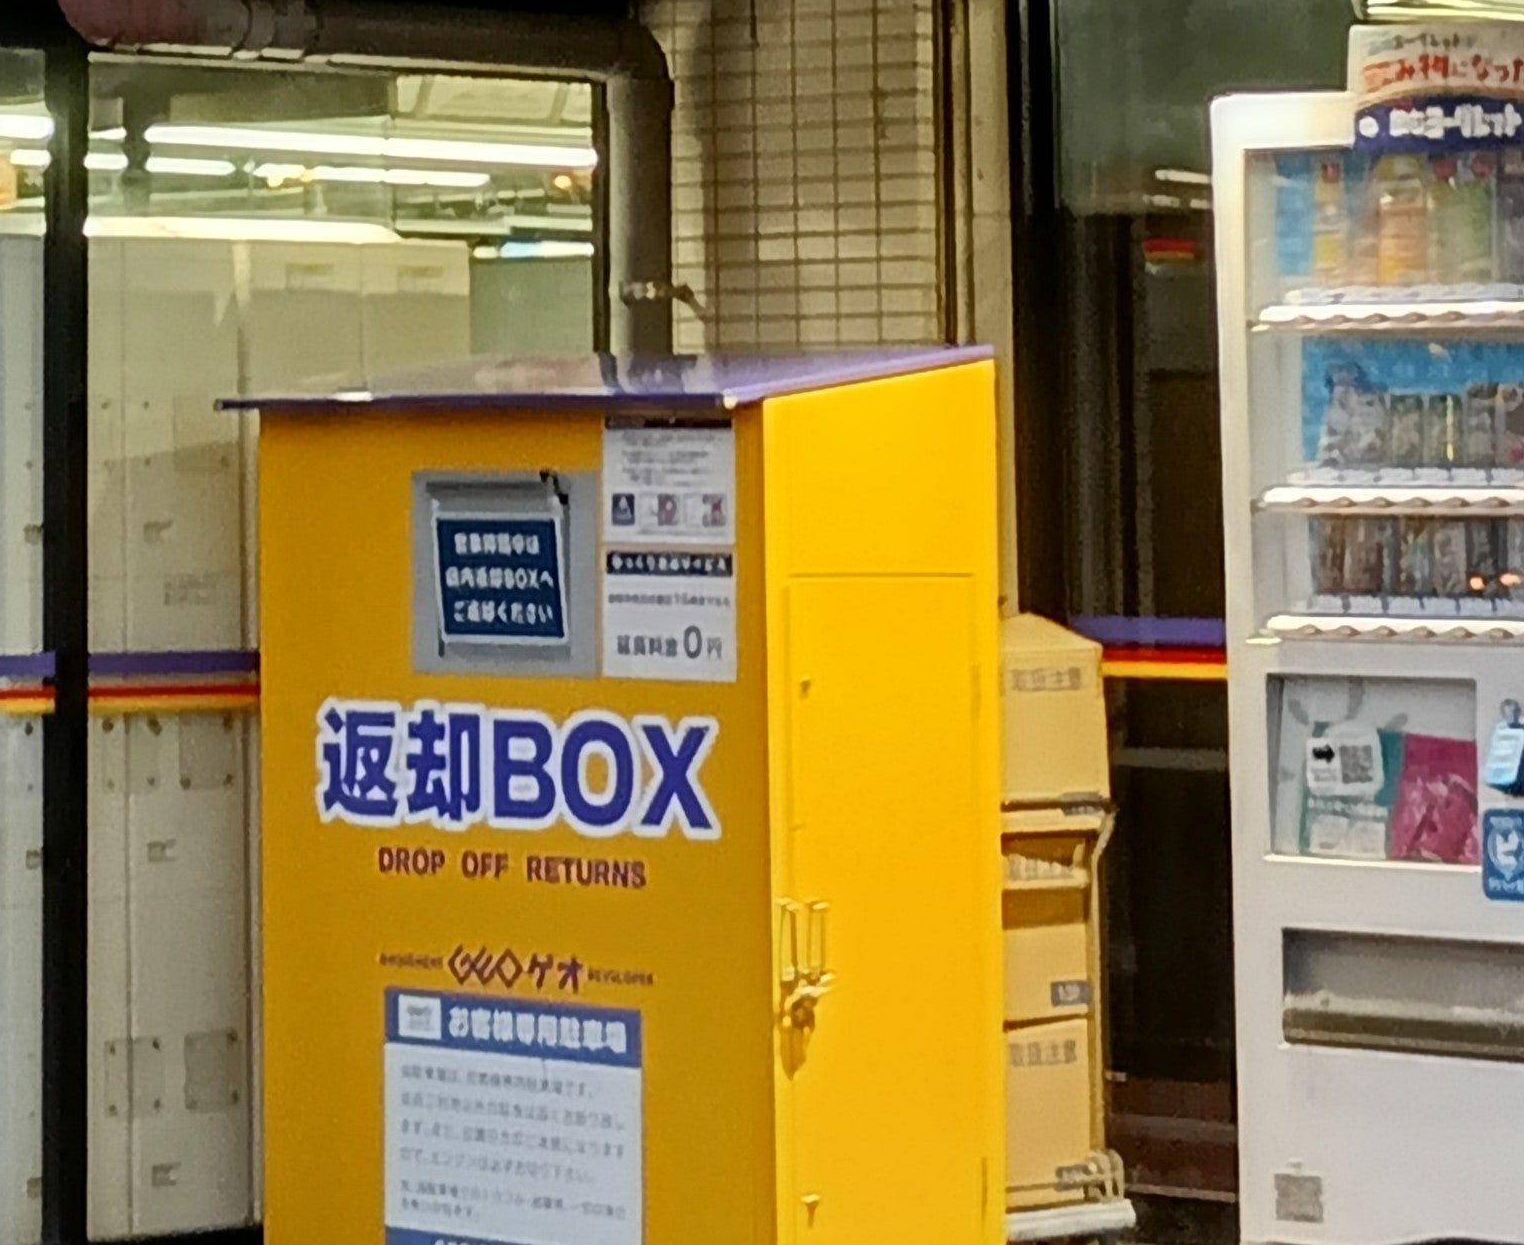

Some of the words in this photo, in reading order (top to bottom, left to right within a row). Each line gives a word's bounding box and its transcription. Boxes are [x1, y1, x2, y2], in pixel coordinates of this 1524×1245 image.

[320, 704, 716, 833] 返却BOX
[378, 846, 446, 878] DROP
[461, 852, 509, 879] OFF
[526, 855, 646, 889] RETURNS
